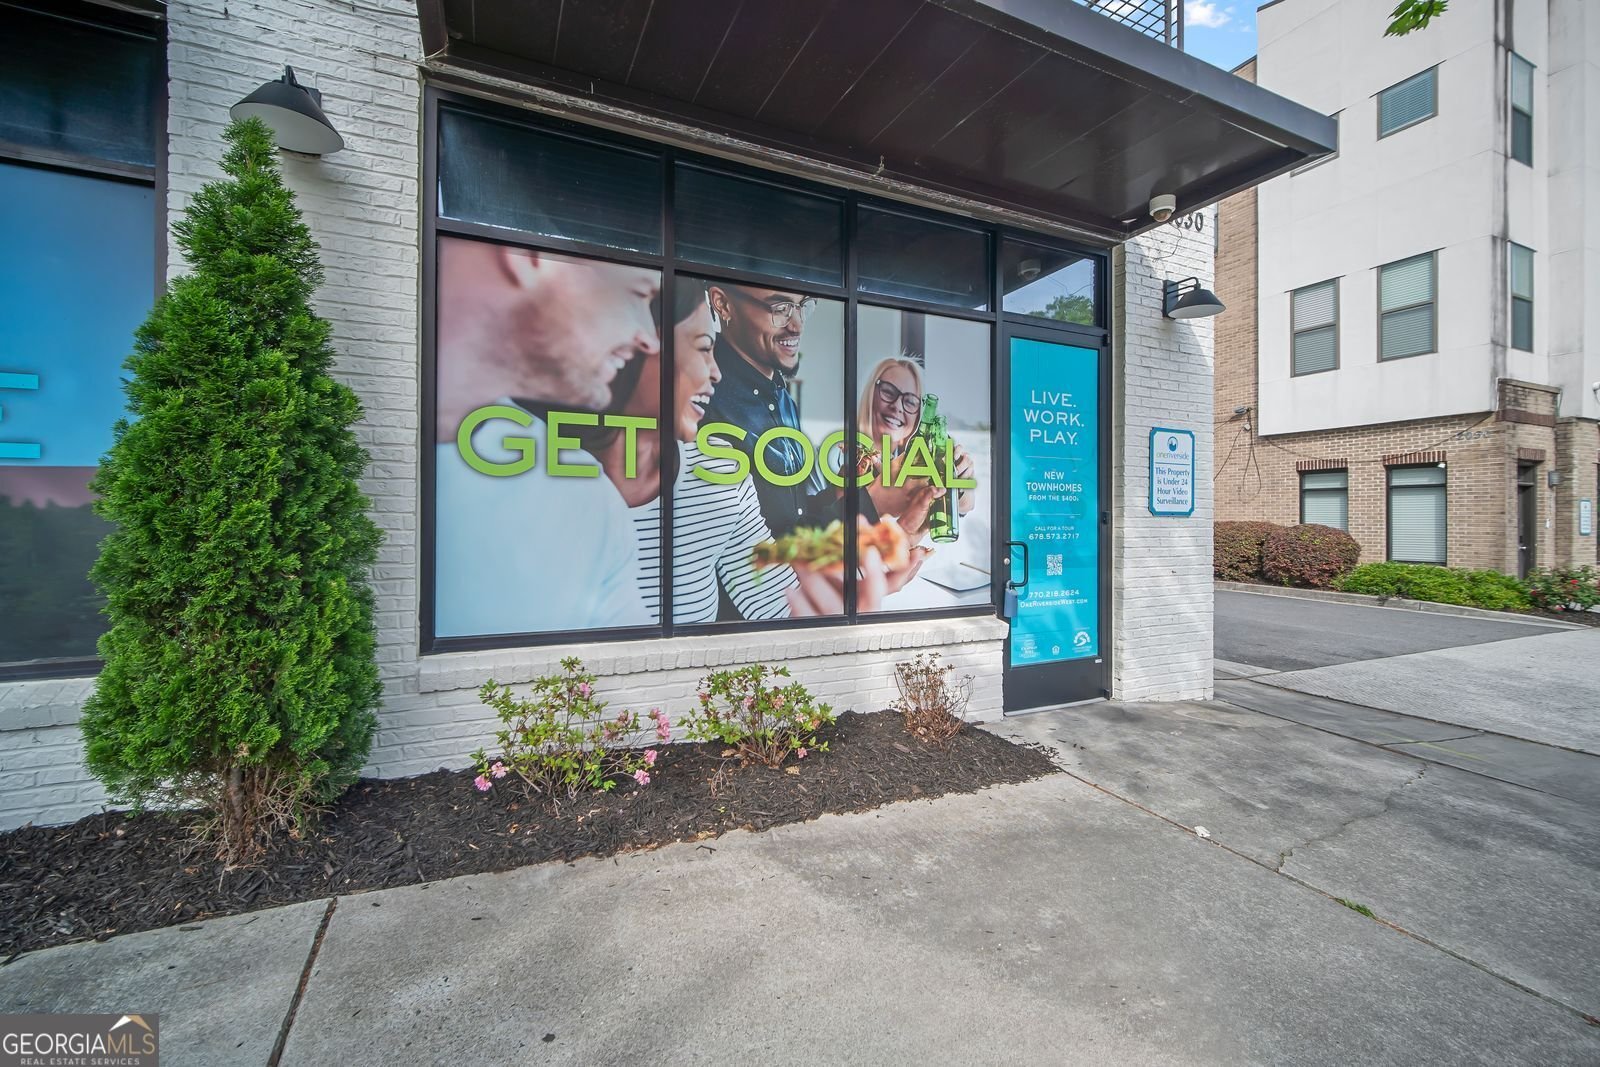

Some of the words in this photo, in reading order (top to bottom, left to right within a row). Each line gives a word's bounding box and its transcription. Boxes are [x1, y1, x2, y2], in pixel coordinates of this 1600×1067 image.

[1031, 390, 1077, 408] LIVE.
[1023, 408, 1085, 428] WORK.
[1030, 429, 1078, 446] PLAY.
[457, 405, 657, 479] GET
[692, 422, 977, 489] SOCIAL
[1044, 471, 1065, 480] NEW
[1155, 467, 1166, 475] This
[1168, 468, 1190, 478] Property
[1026, 482, 1083, 492] TOWNHOMES
[1157, 487, 1171, 495] Hour
[1172, 487, 1188, 496] Video
[1156, 497, 1188, 505] Surveillance
